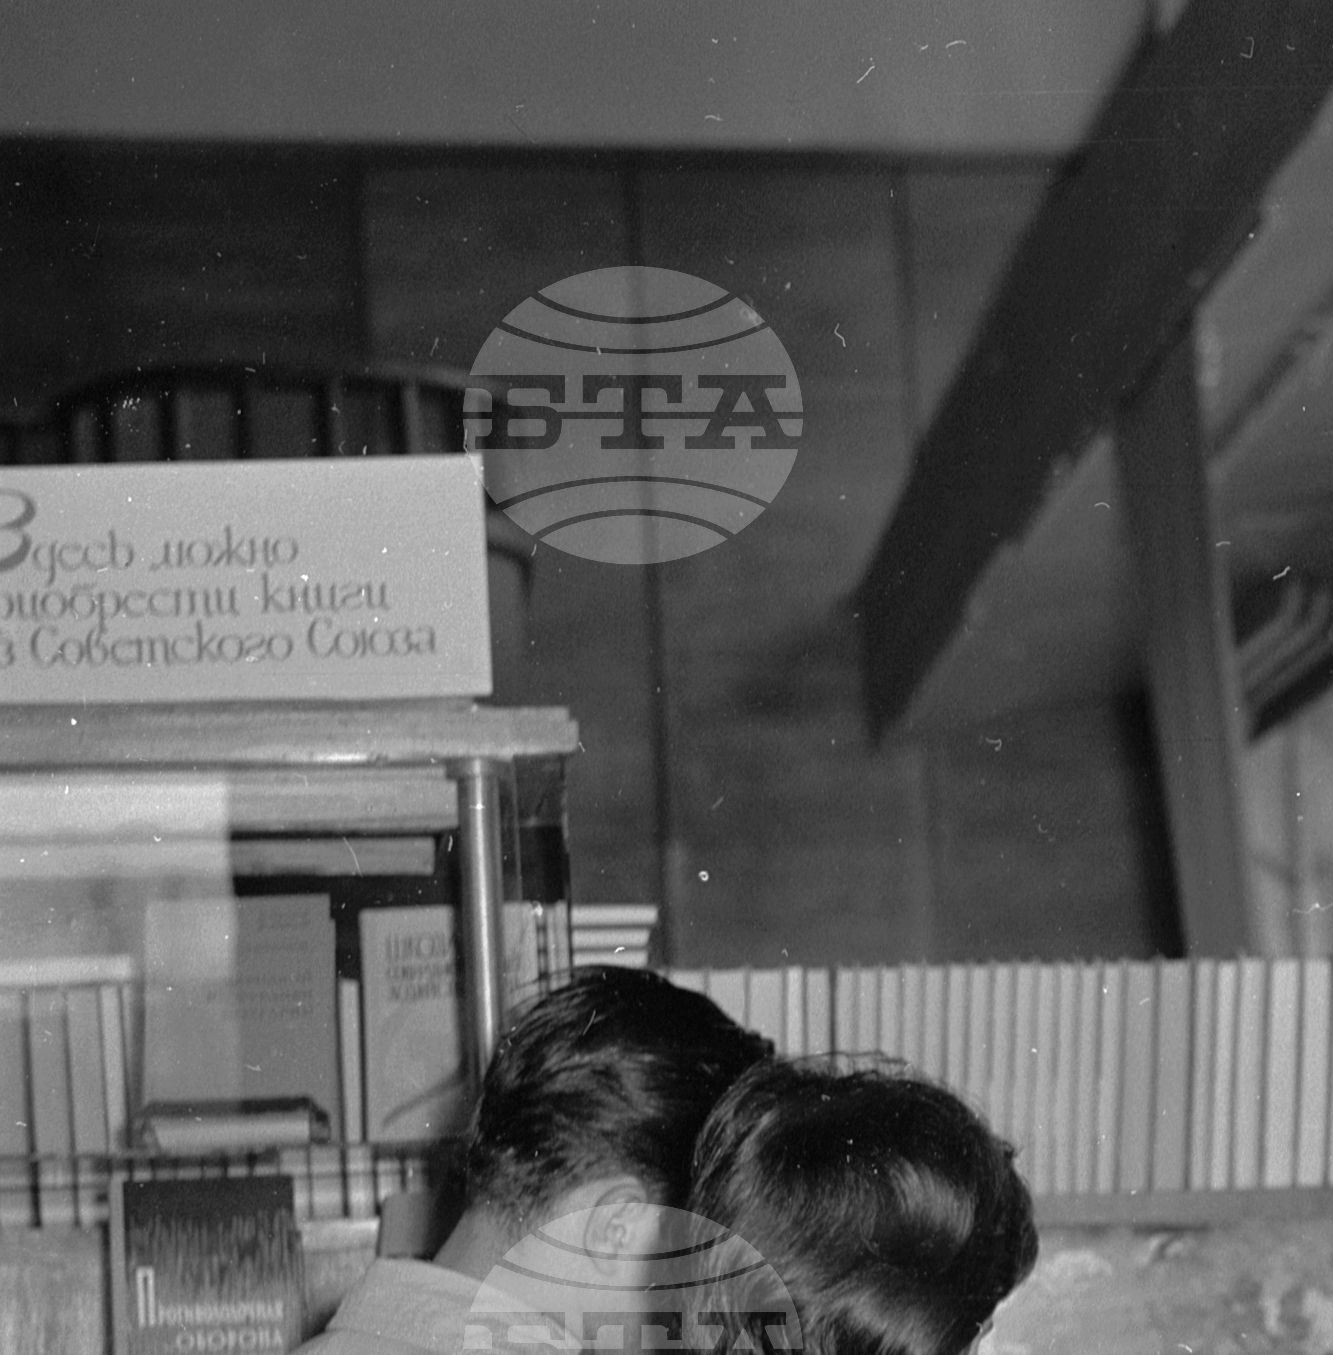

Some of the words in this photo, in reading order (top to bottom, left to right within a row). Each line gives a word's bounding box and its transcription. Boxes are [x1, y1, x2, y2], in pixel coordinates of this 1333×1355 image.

[150, 523, 299, 572] можно
[261, 571, 391, 614] книги
[30, 618, 294, 667] Советского
[306, 616, 436, 658] Союза
